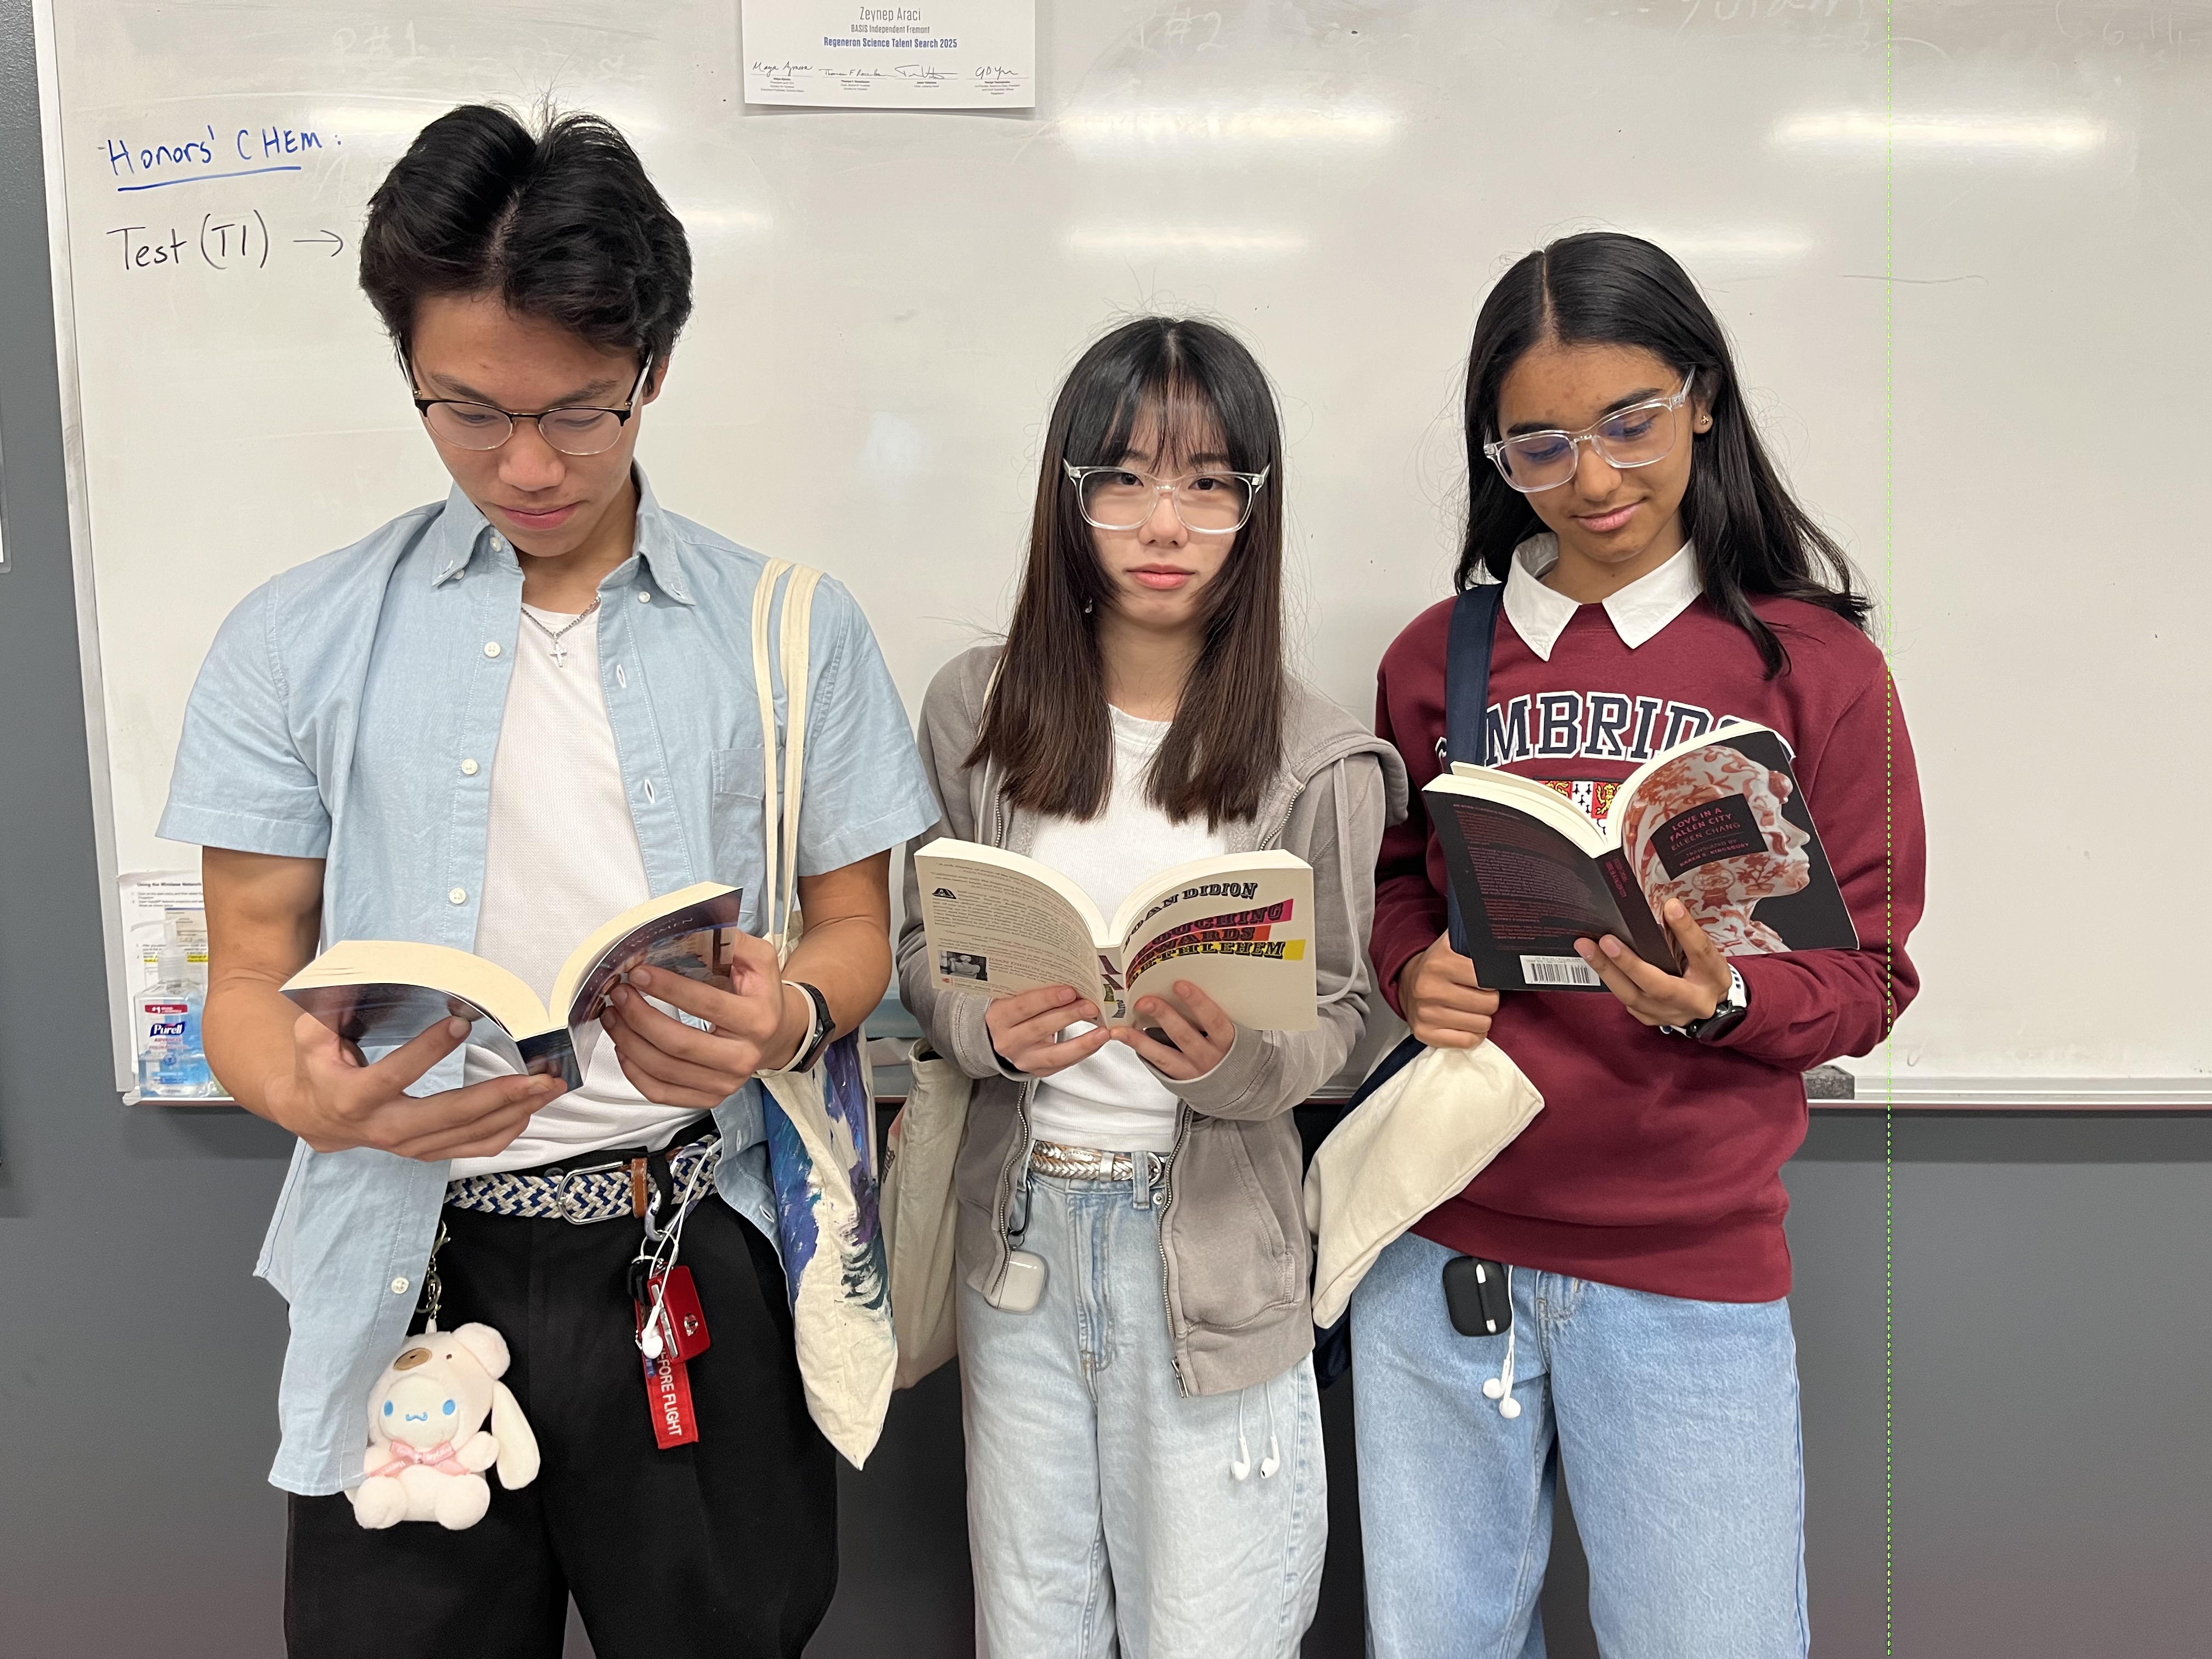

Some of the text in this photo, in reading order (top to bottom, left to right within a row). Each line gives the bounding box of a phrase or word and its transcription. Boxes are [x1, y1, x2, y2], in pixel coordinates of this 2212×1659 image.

[860, 7, 921, 22] Zeynep Araci
[851, 24, 930, 33] BASIS Independent Fremont
[823, 37, 957, 48] Regeneron Science Talent Search 2025
[108, 125, 214, 176] Honors'
[106, 226, 188, 270] Test
[1435, 690, 1796, 769] MBRID
[1669, 813, 1733, 842] FALLEN CITY
[1672, 815, 1698, 831] LOVE
[1700, 810, 1712, 819] IN
[1671, 822, 1741, 851] EILEEN CHANG
[1182, 882, 1258, 900] DIDION
[1011, 961, 1040, 971] DIDION
[657, 1347, 682, 1436] EFORE FLIGHT
